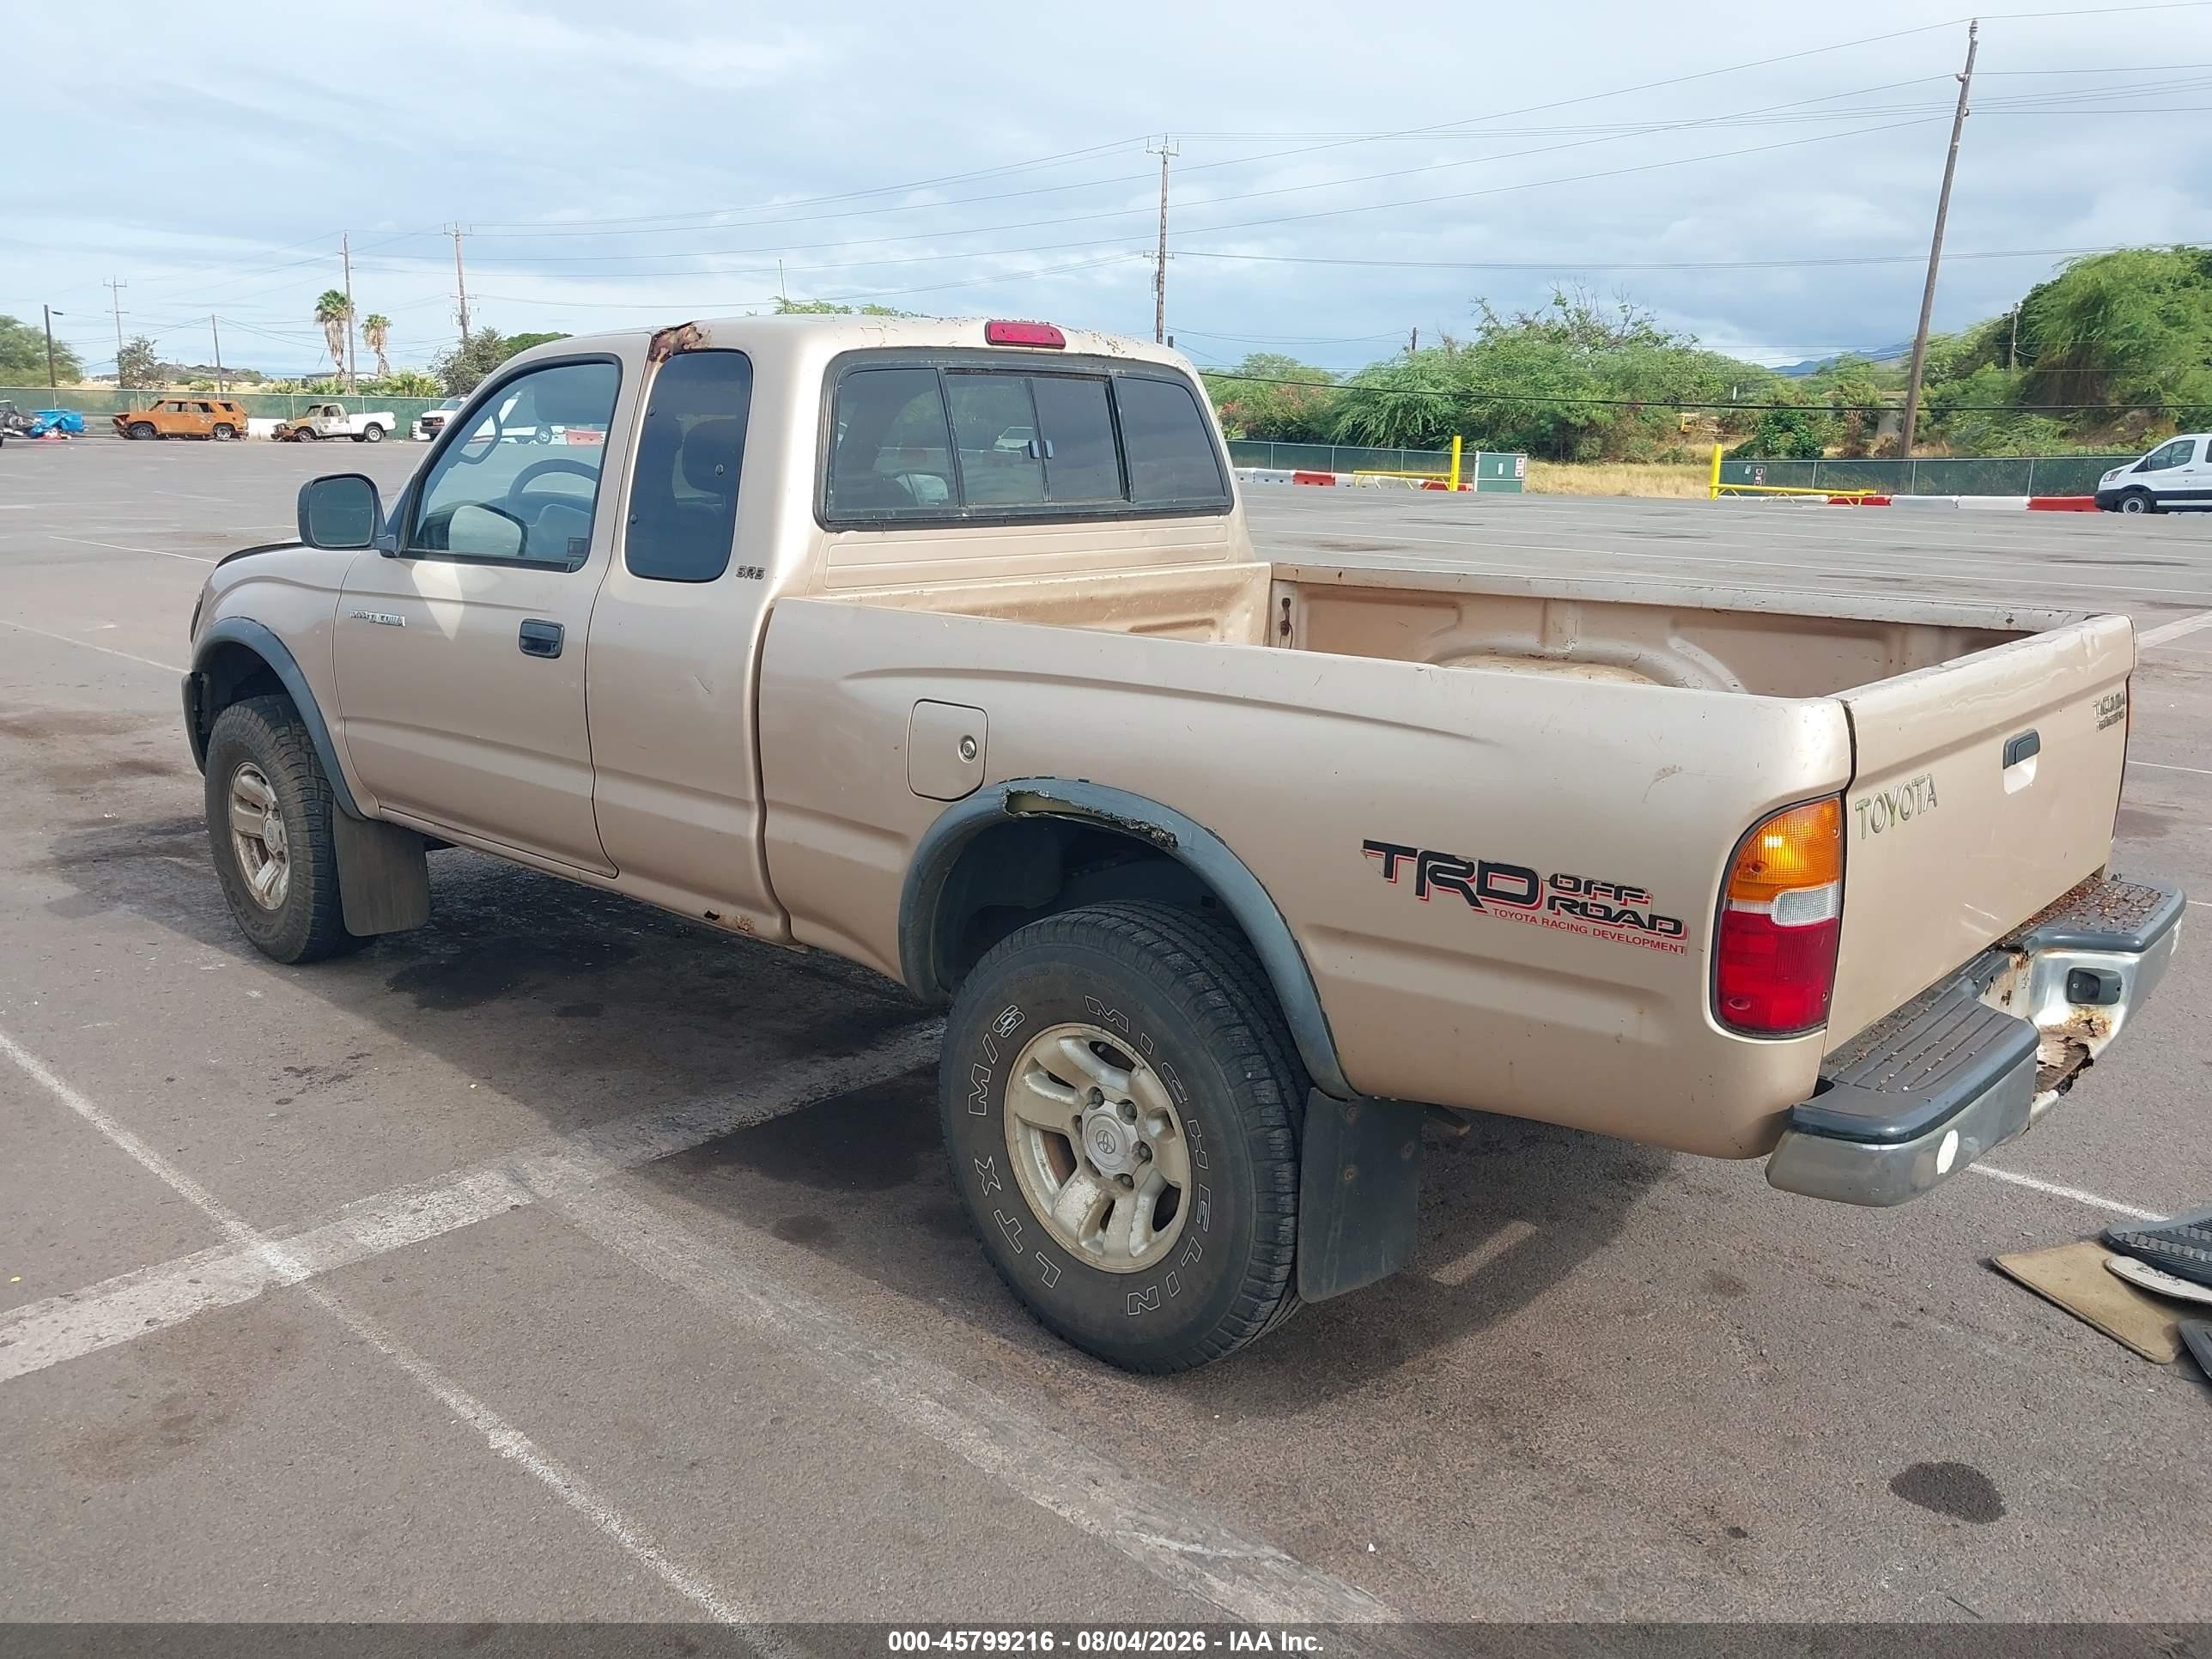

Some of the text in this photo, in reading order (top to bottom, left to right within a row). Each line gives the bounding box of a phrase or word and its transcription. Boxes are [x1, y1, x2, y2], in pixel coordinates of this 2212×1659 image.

[1855, 773, 1938, 840] TOYOTA
[1361, 839, 1544, 914] TRD
[1548, 872, 1652, 907] OFF
[1492, 907, 1687, 956] TOYOTA RACING DEVELOPMENT
[1547, 895, 1689, 941] ROAD
[968, 1005, 1061, 1289] LTX M/S
[1084, 994, 1211, 1316] MICHELIN
